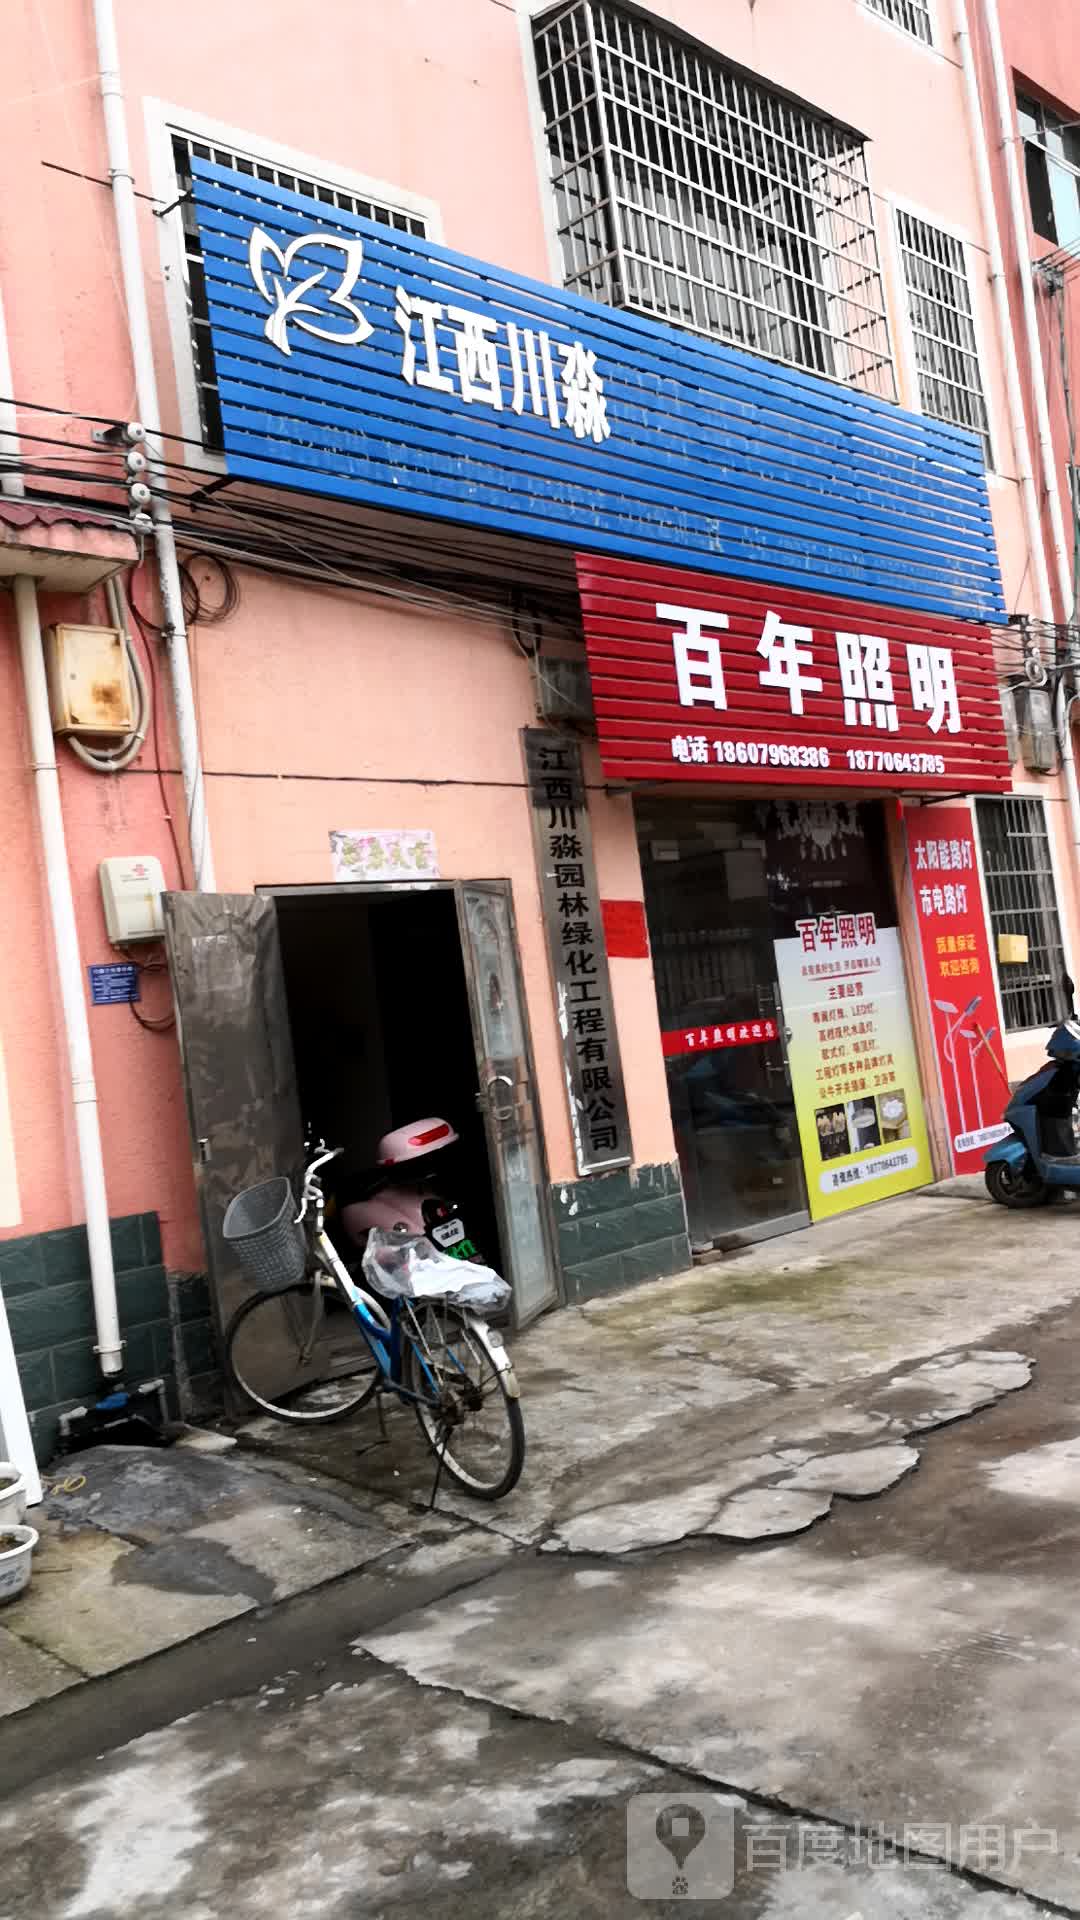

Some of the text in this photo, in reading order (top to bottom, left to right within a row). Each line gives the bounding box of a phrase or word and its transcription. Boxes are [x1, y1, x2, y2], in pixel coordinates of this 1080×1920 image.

[394, 284, 611, 444] 江西川淼
[655, 602, 962, 734] 百年照明
[671, 735, 945, 774] 电话 18607968386 18770643785
[914, 839, 973, 870] 太阳能路灯
[919, 884, 967, 916] 市电路灯
[538, 747, 618, 1151] 江西川淼园林绿化工程有限公司
[796, 912, 877, 952] 百年照明
[936, 934, 976, 954] 质量保证
[939, 957, 980, 977] 欢迎咨询
[827, 981, 864, 1000] 主要经营
